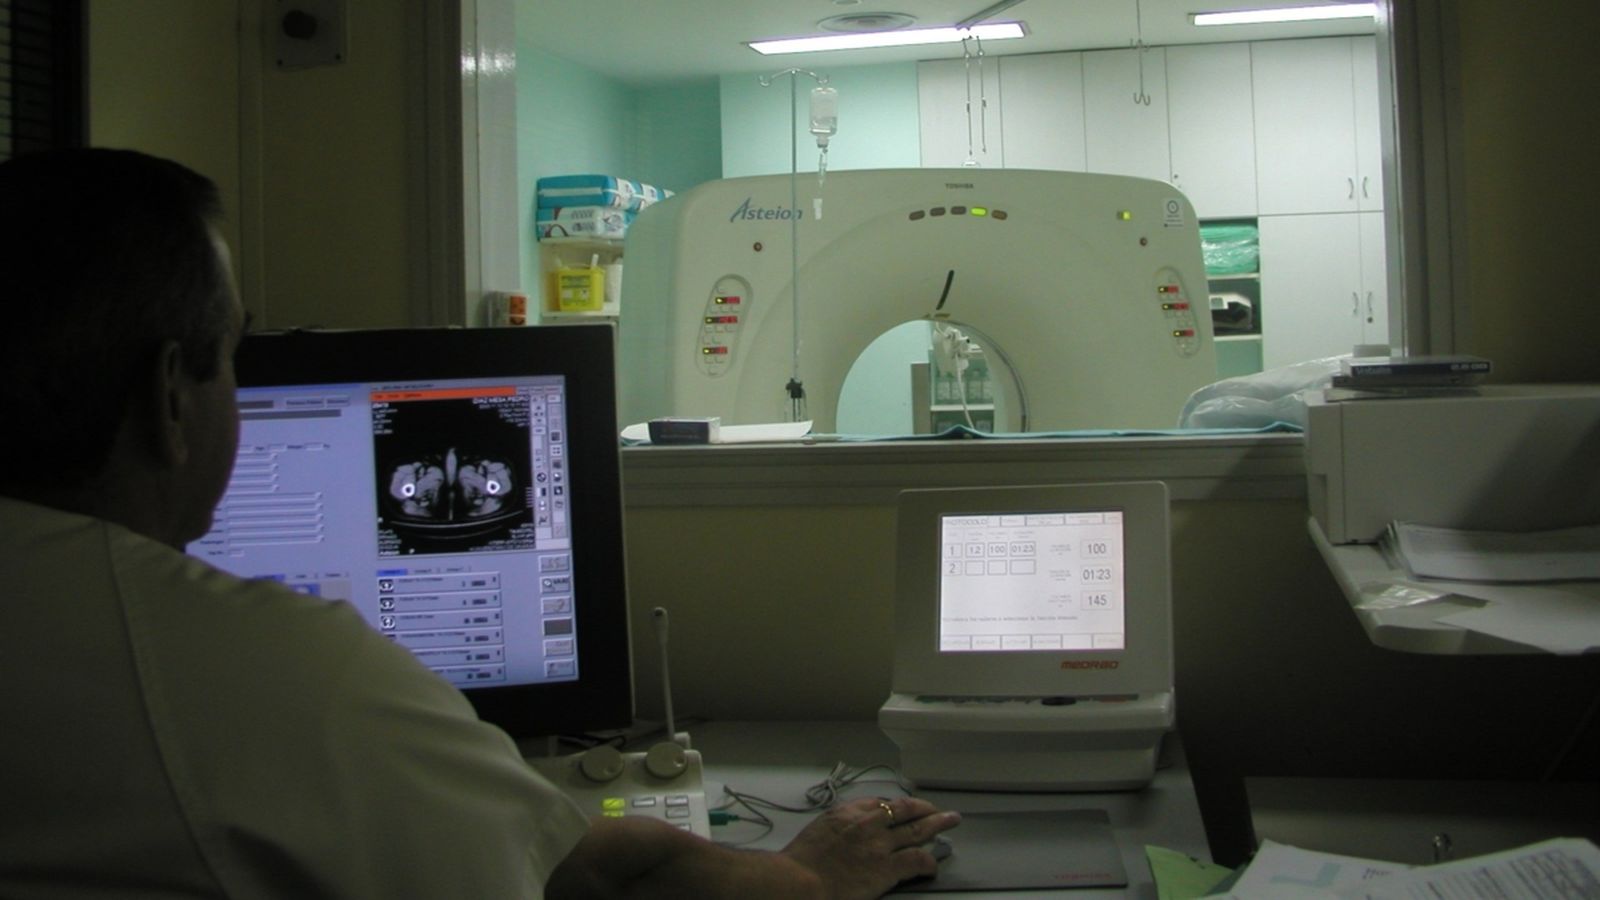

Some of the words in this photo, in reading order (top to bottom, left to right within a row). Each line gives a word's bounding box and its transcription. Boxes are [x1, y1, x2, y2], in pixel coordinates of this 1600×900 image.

[730, 197, 803, 223] Asteion
[990, 544, 1005, 554] 100
[1087, 544, 1106, 555] 100
[949, 564, 956, 574] 2
[1087, 595, 1107, 606] 145
